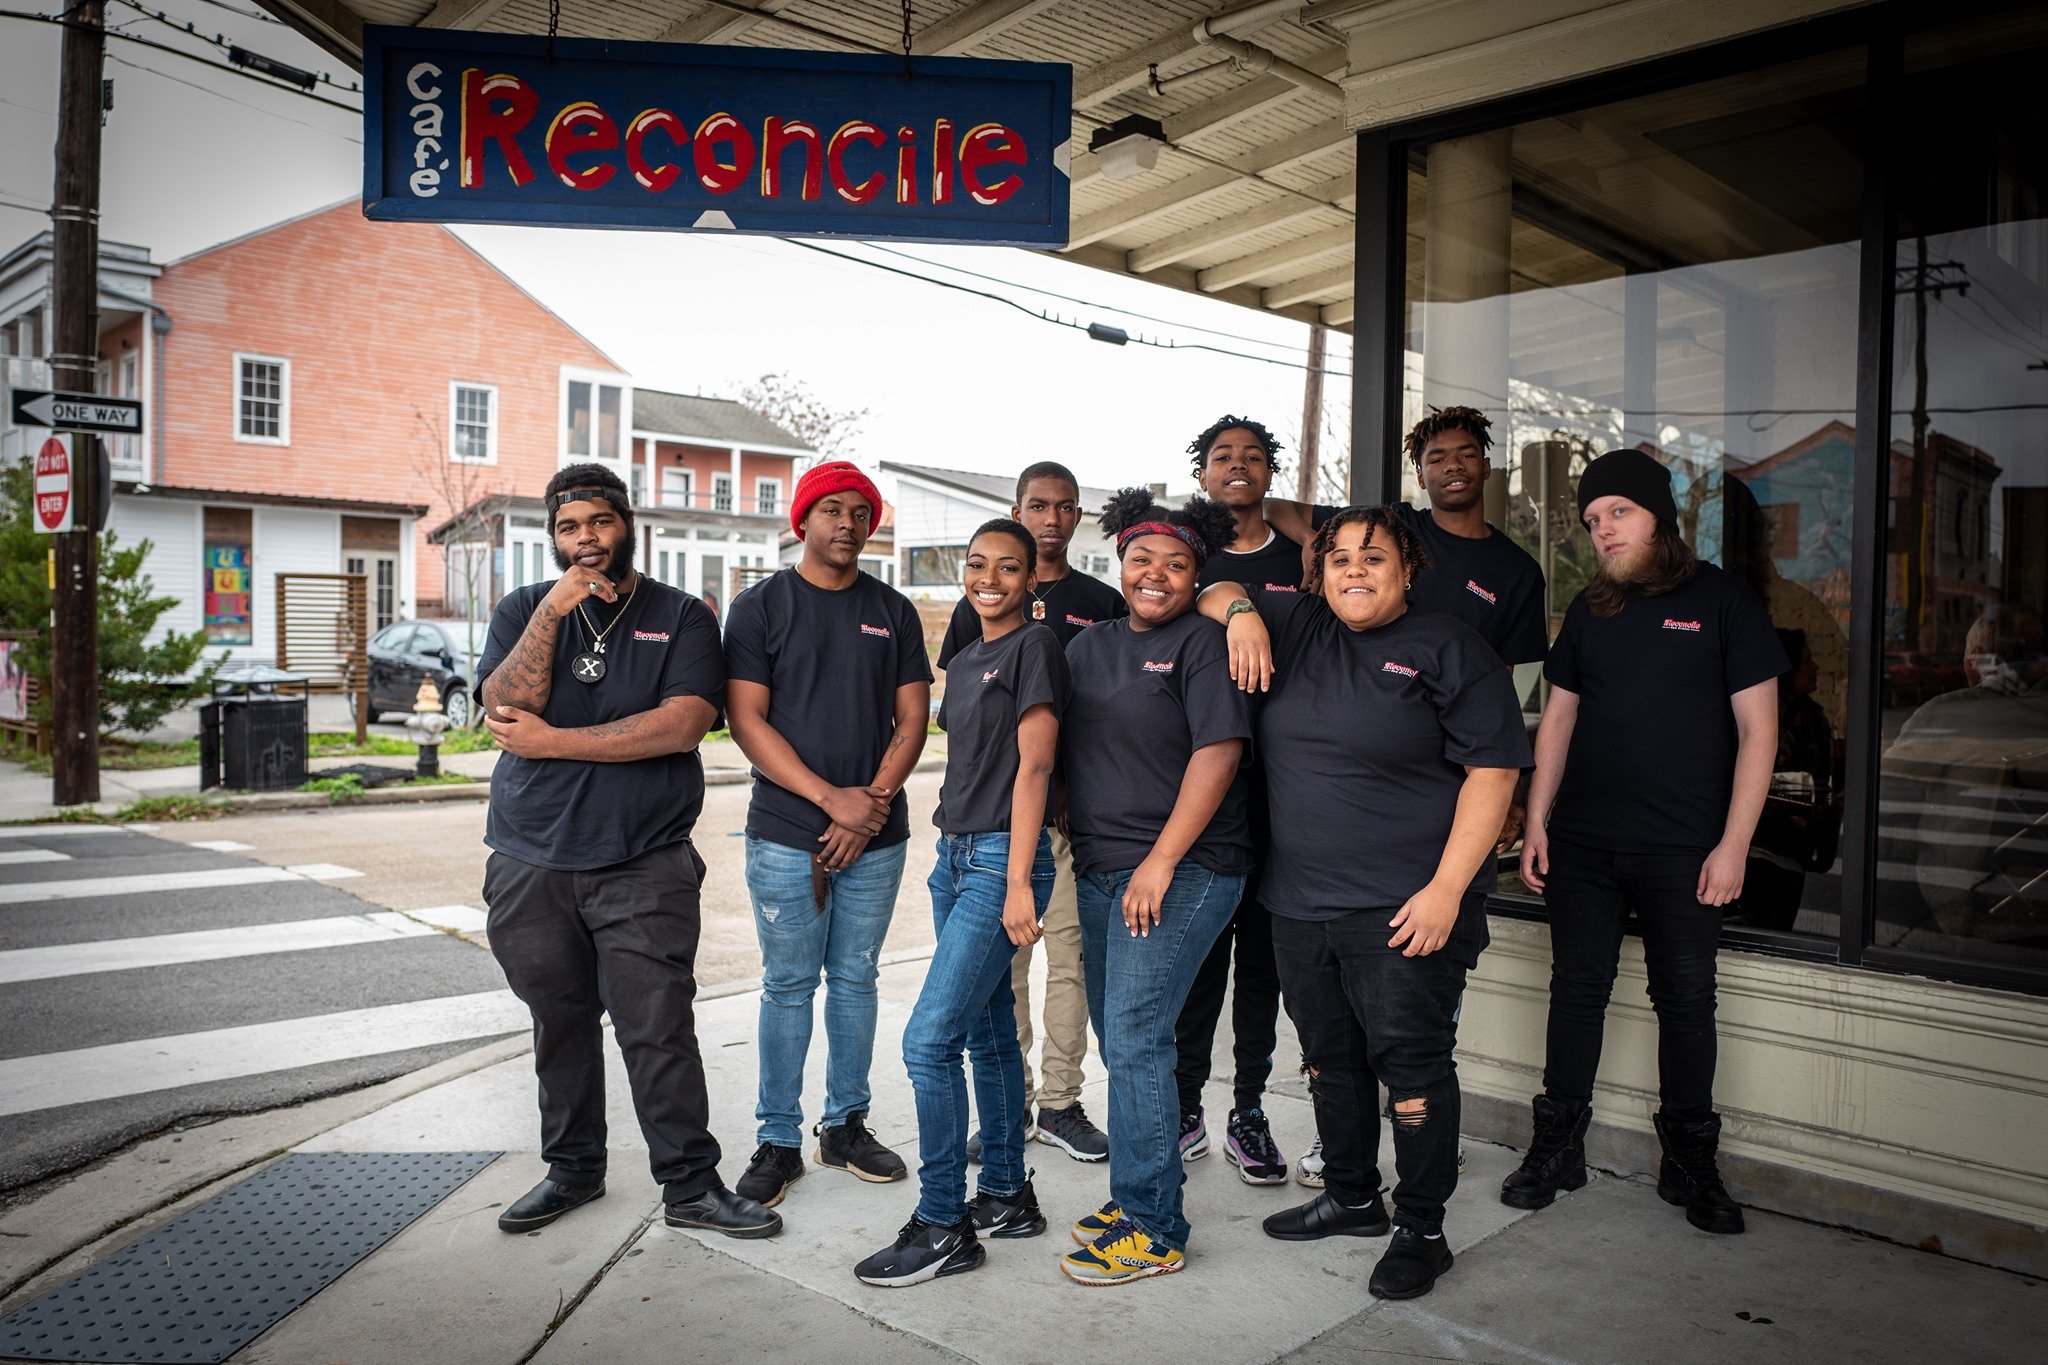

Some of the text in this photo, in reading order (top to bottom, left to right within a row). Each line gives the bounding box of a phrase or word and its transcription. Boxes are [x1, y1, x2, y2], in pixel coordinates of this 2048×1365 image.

[460, 67, 1028, 205] Reconcile
[52, 404, 128, 422] ONE WAY
[39, 453, 66, 472] DO NOT
[41, 496, 64, 513] ENTER
[579, 657, 600, 677] X
[1112, 1255, 1158, 1269] Reebok
